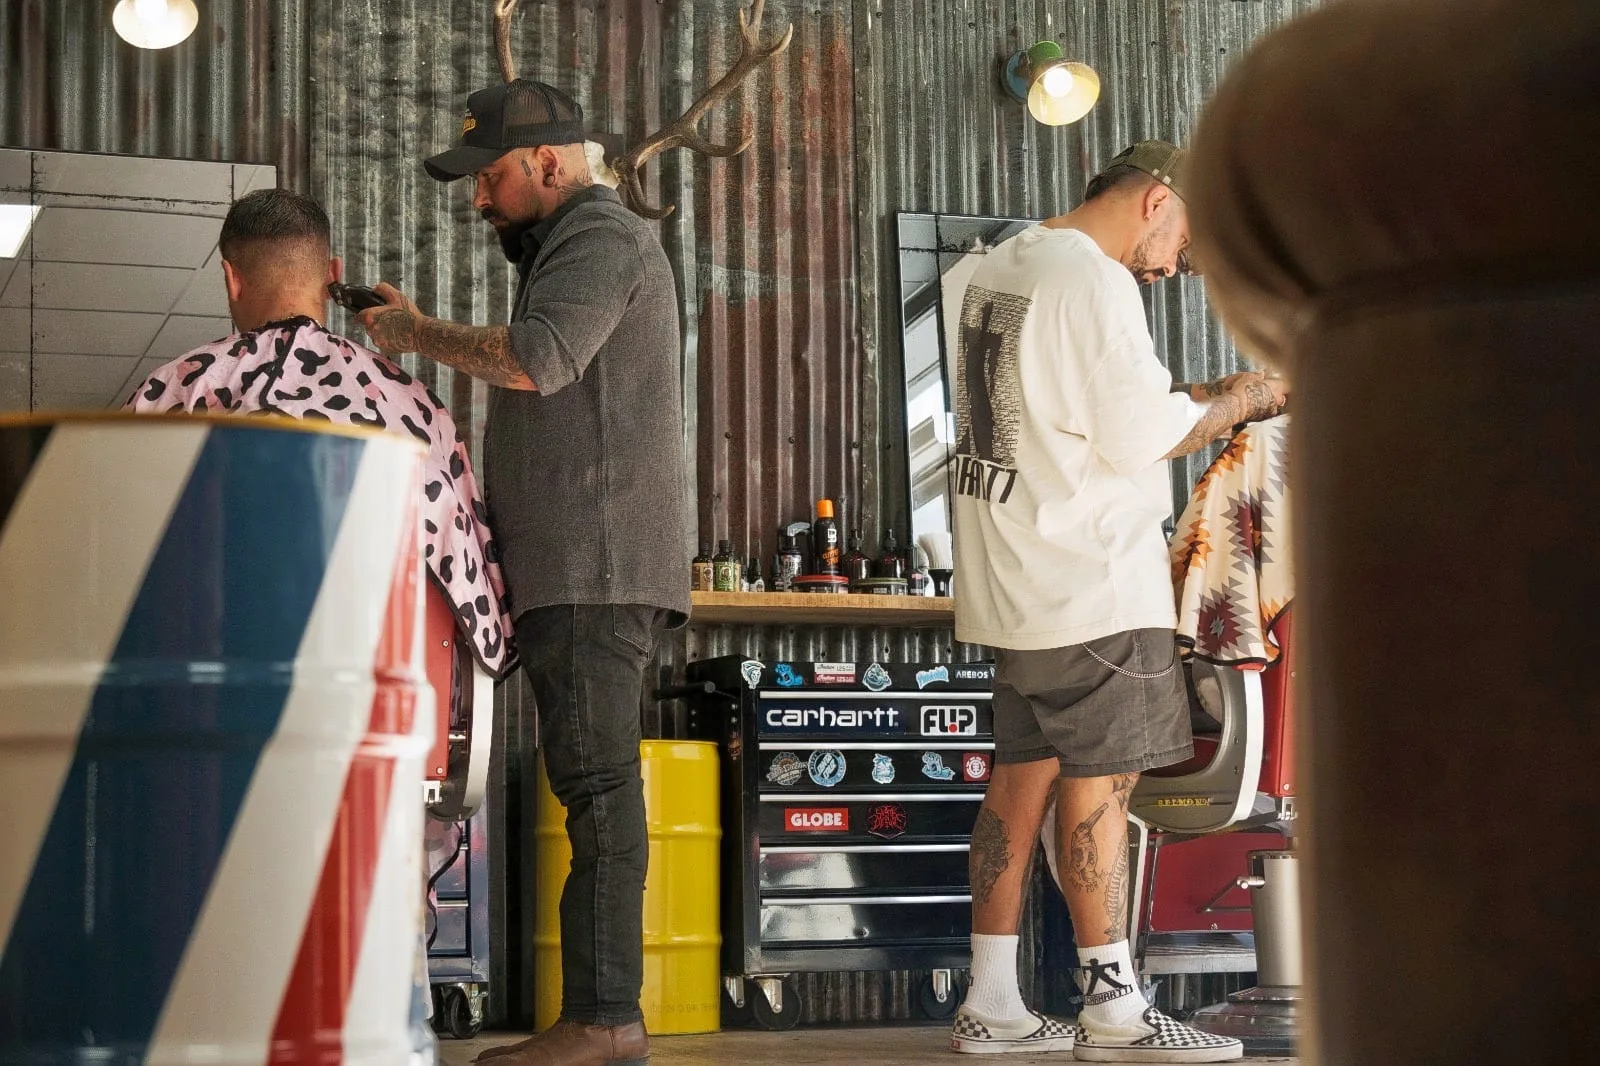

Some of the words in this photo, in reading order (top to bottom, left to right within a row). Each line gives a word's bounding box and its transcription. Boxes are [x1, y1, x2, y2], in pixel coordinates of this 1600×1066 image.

[955, 670, 989, 679] AREBOS
[766, 706, 899, 727] carhartt
[923, 708, 974, 733] FLIP
[790, 812, 842, 827] GLOBE
